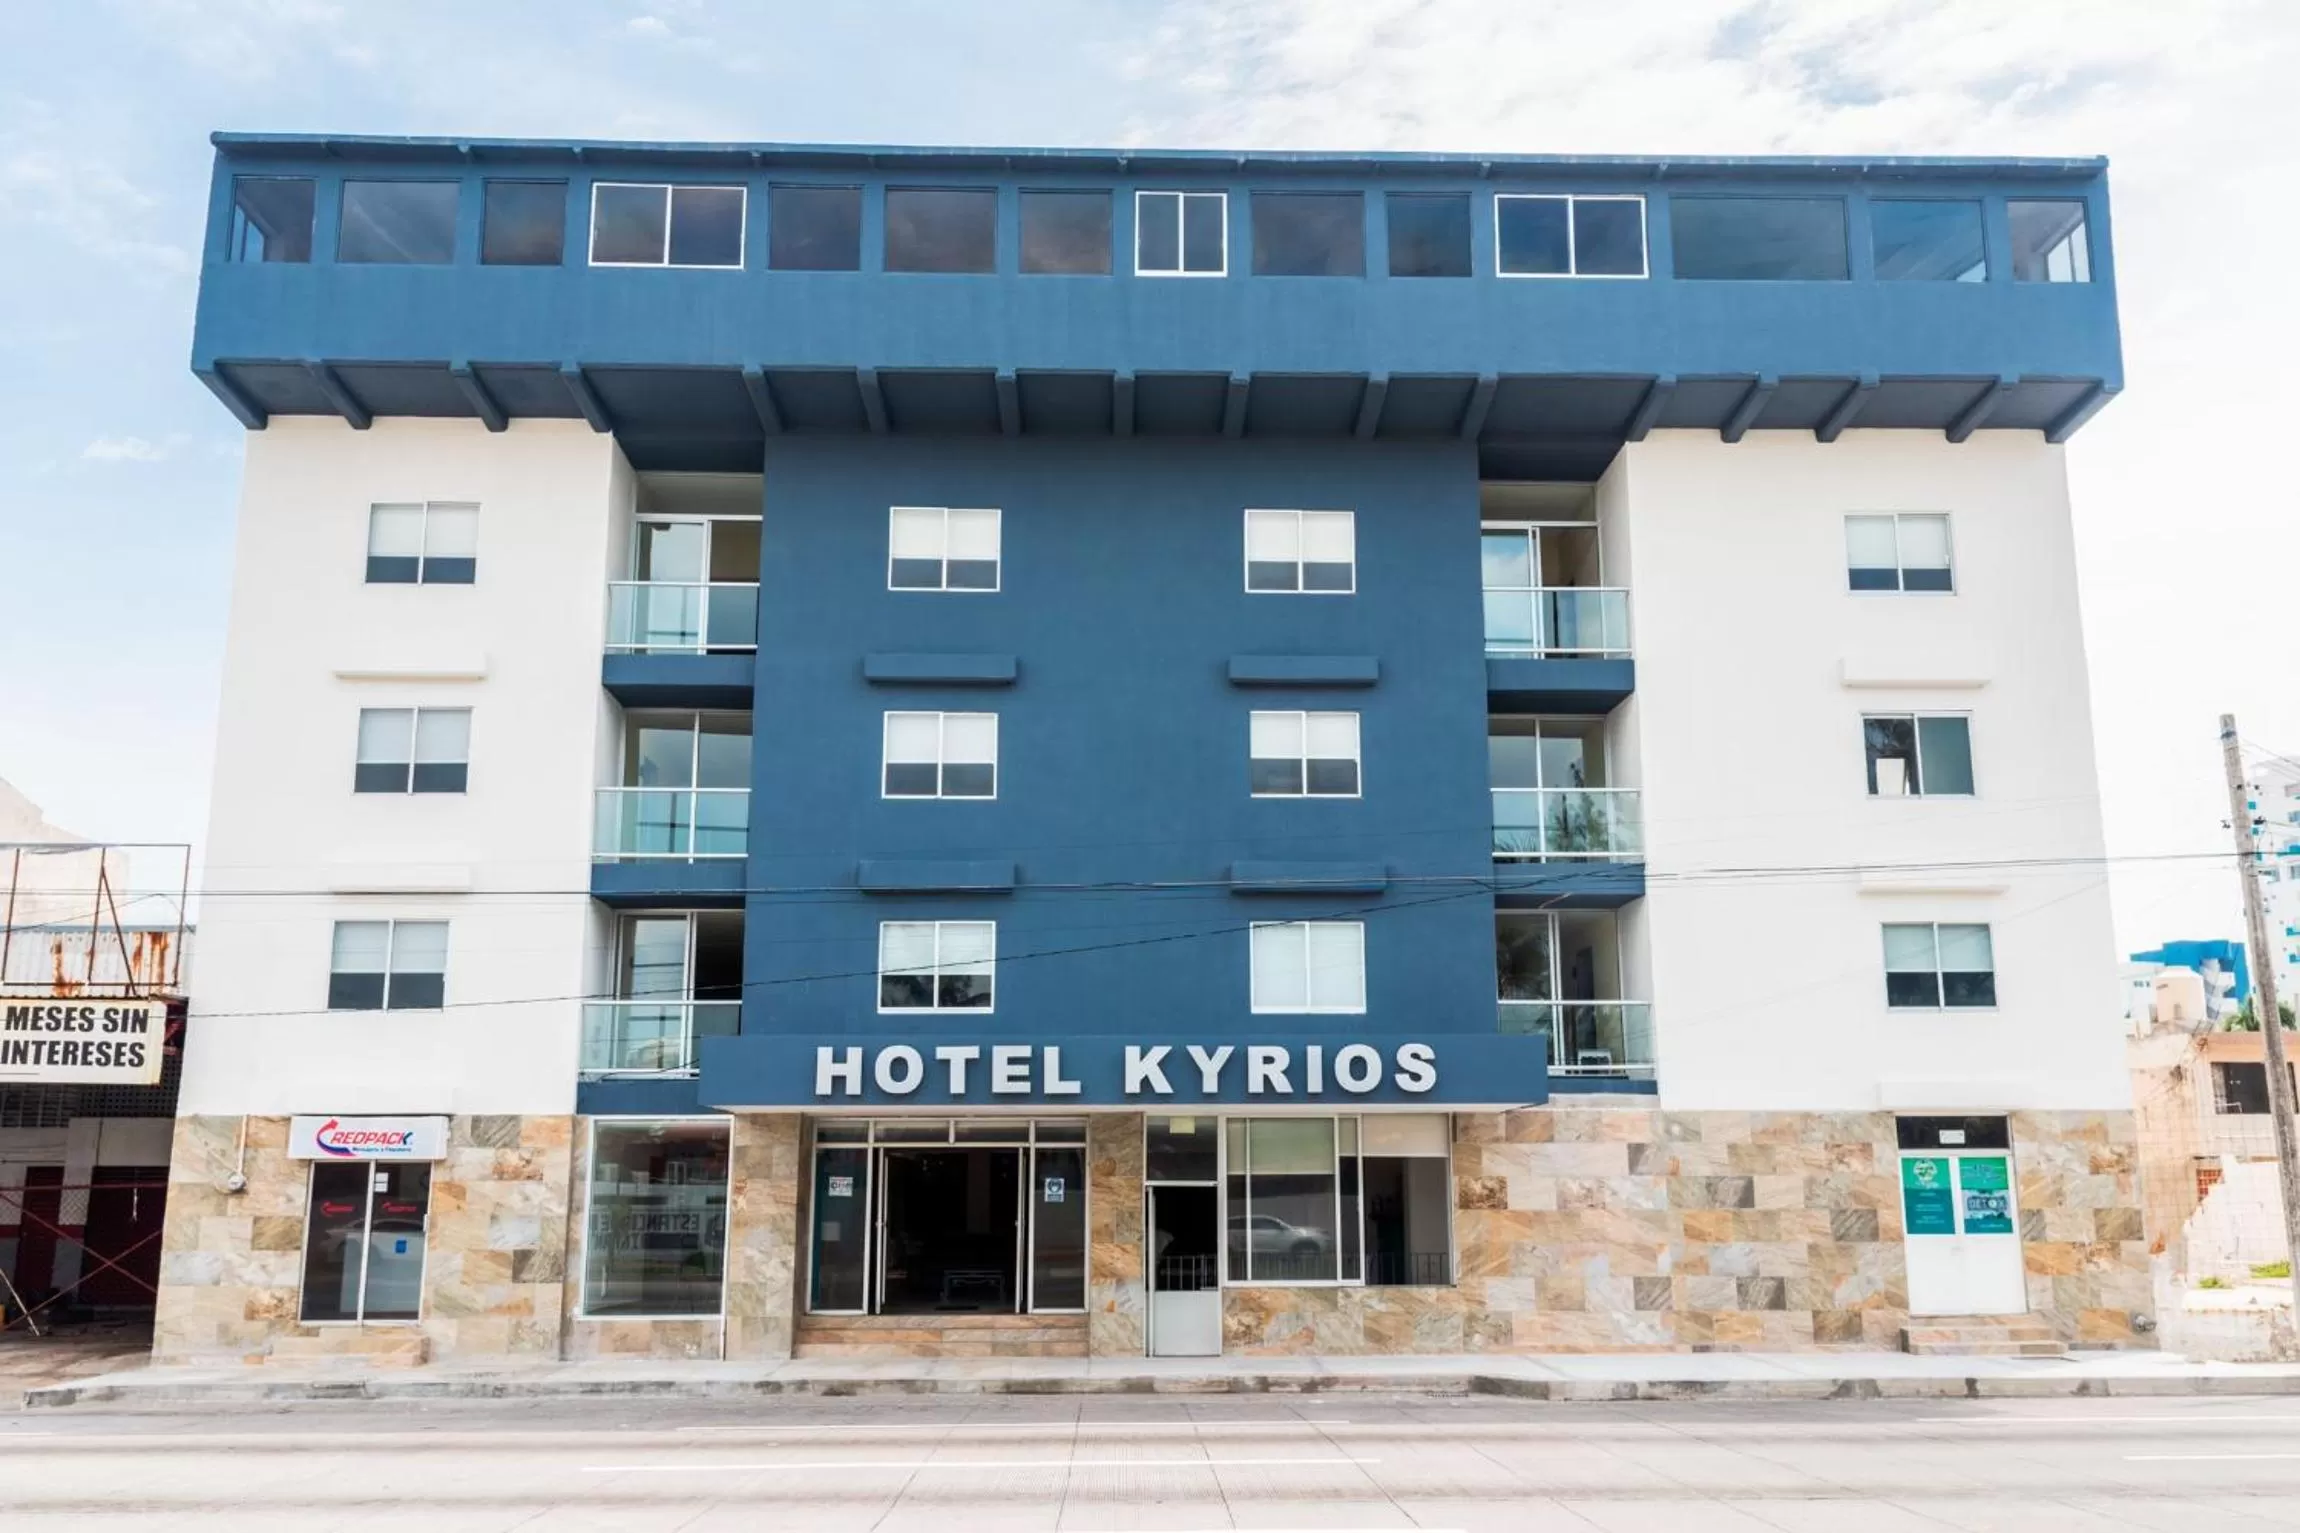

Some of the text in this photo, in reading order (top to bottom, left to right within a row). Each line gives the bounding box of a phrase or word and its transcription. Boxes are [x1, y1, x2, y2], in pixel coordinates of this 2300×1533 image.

[5, 1006, 149, 1033] MESES SIN
[0, 1040, 145, 1067] INTERESES
[815, 1043, 1437, 1095] HOTEL KYRIOS
[330, 1131, 413, 1145] REDPACK
